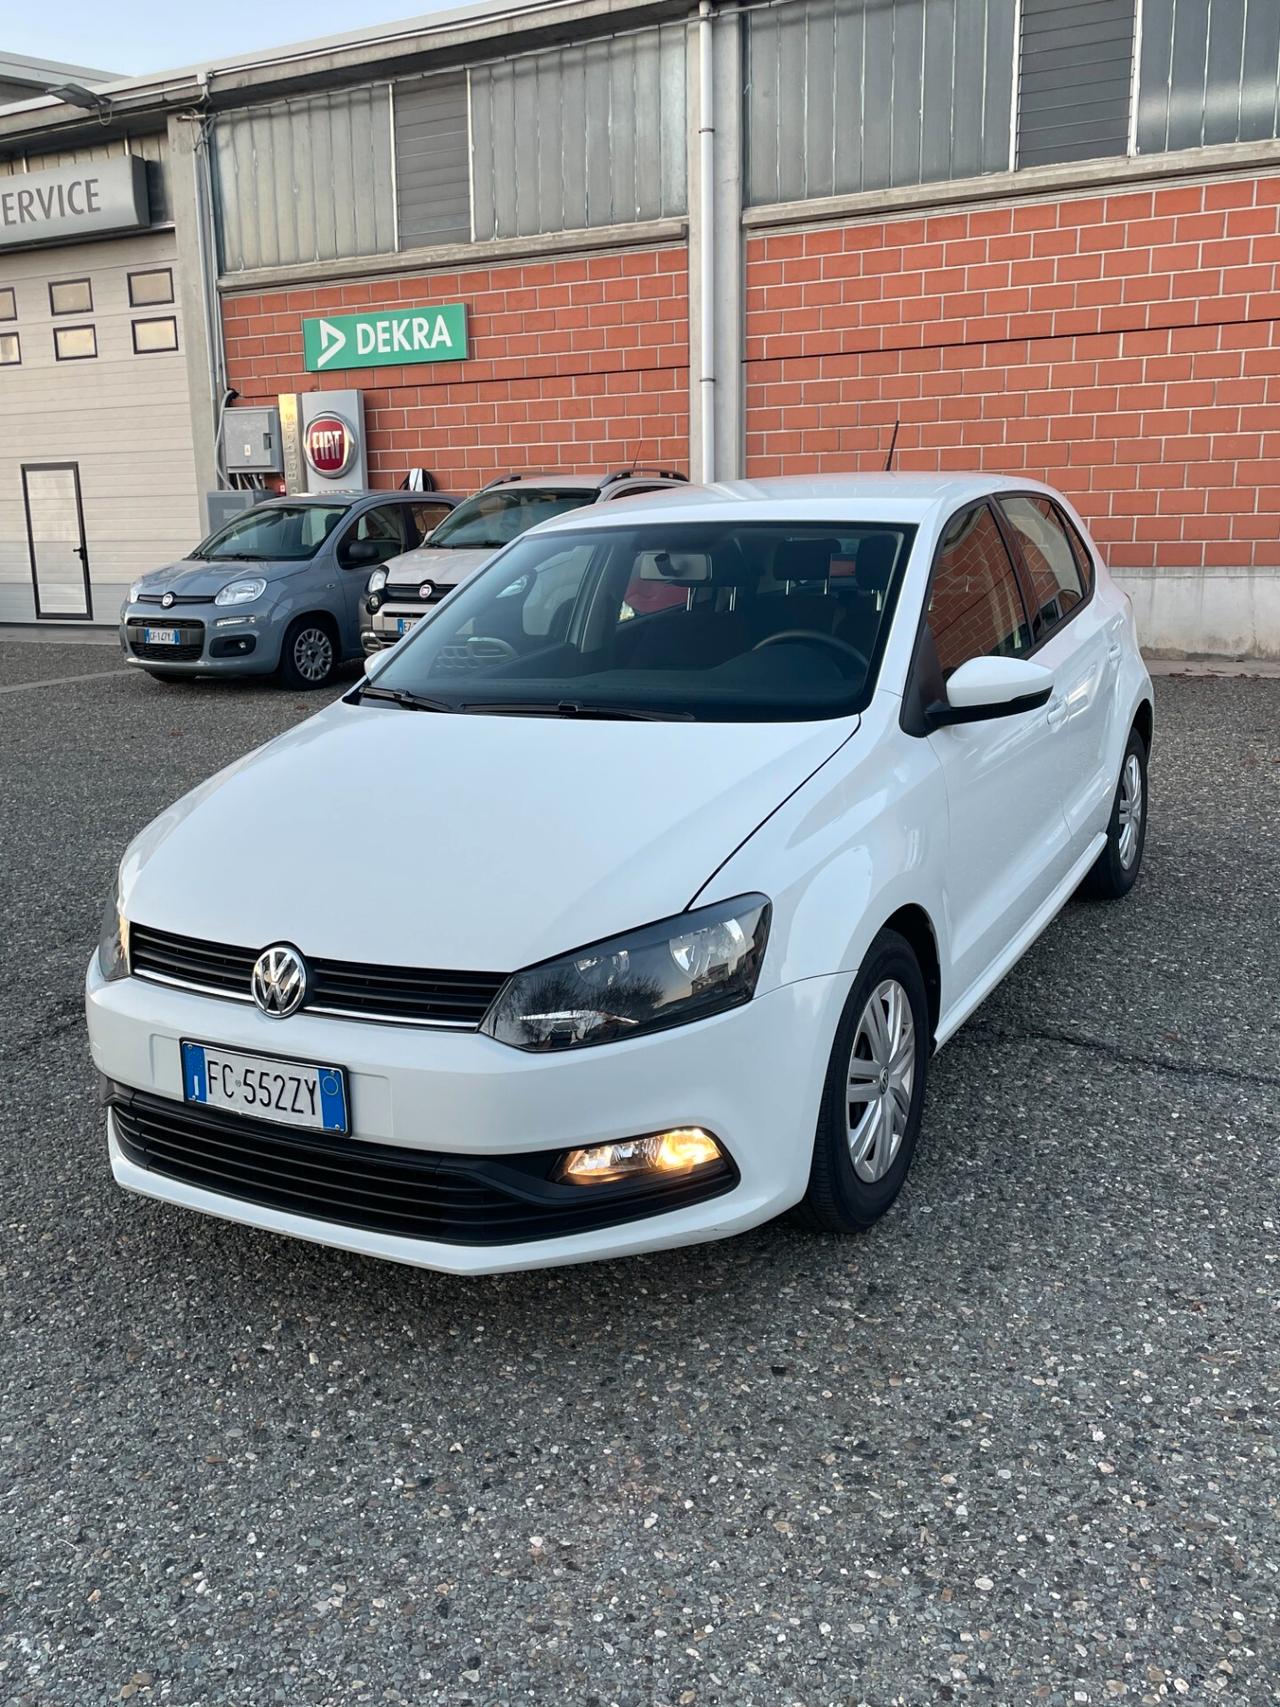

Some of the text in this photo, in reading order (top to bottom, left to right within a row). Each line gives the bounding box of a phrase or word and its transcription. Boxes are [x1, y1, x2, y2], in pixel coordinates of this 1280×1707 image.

[1, 178, 102, 226] ERVICE
[356, 314, 453, 355] DEKRA
[312, 431, 342, 459] FIAT
